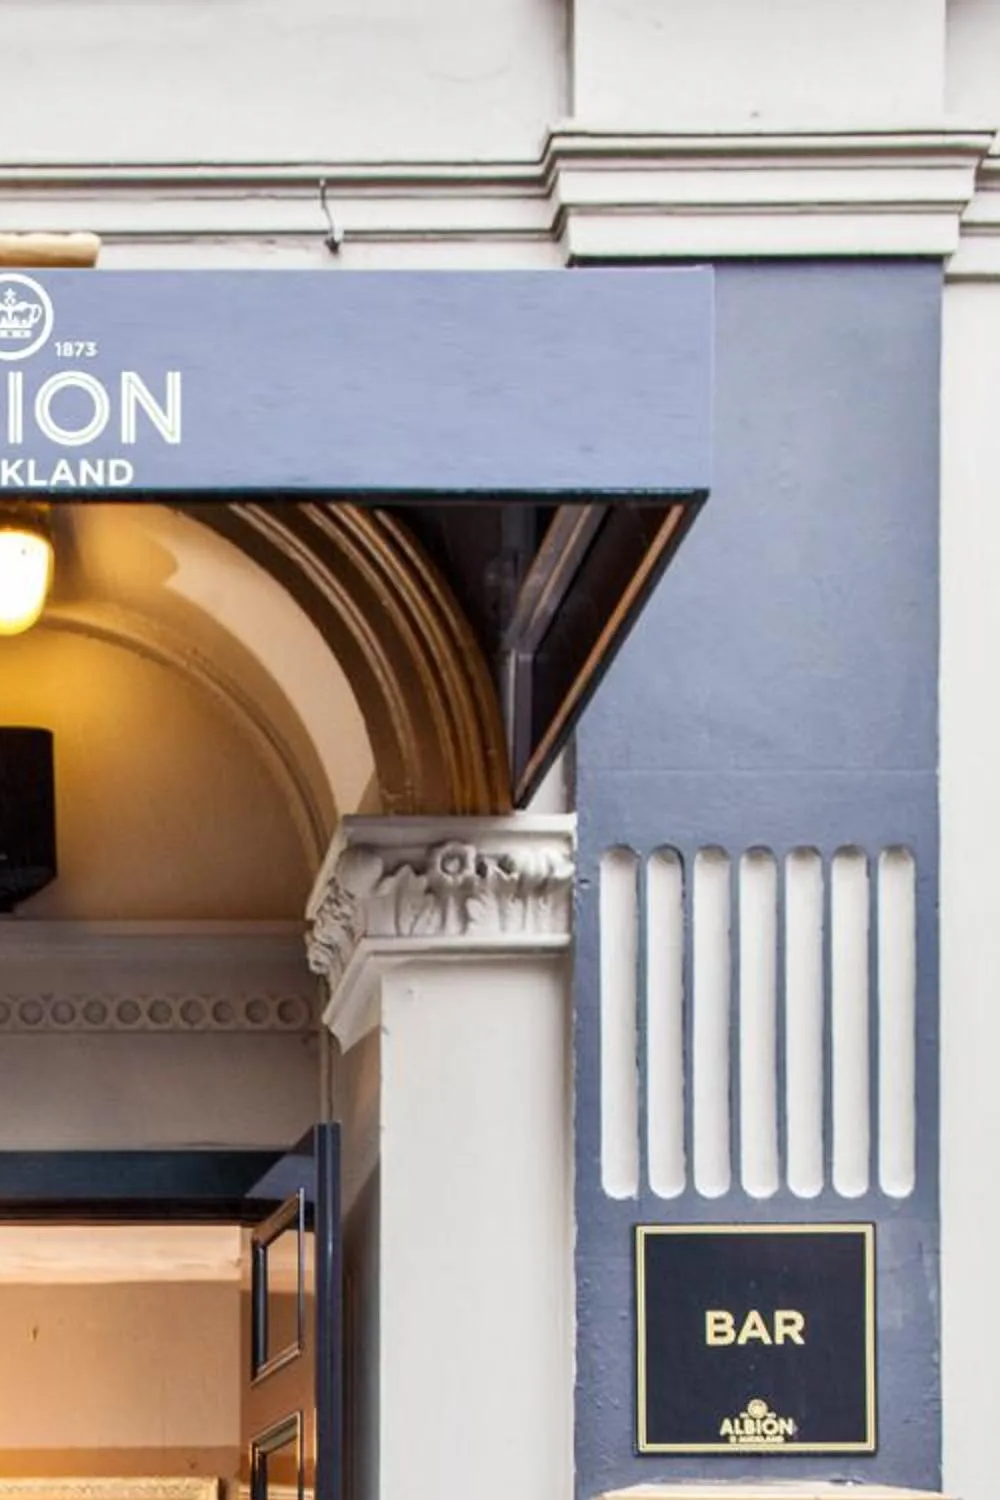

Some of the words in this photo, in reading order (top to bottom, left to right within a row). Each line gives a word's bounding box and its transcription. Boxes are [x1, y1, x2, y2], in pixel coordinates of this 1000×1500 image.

[54, 341, 99, 358] 1873
[704, 1309, 806, 1345] BAR
[720, 1417, 794, 1437] ALBION
